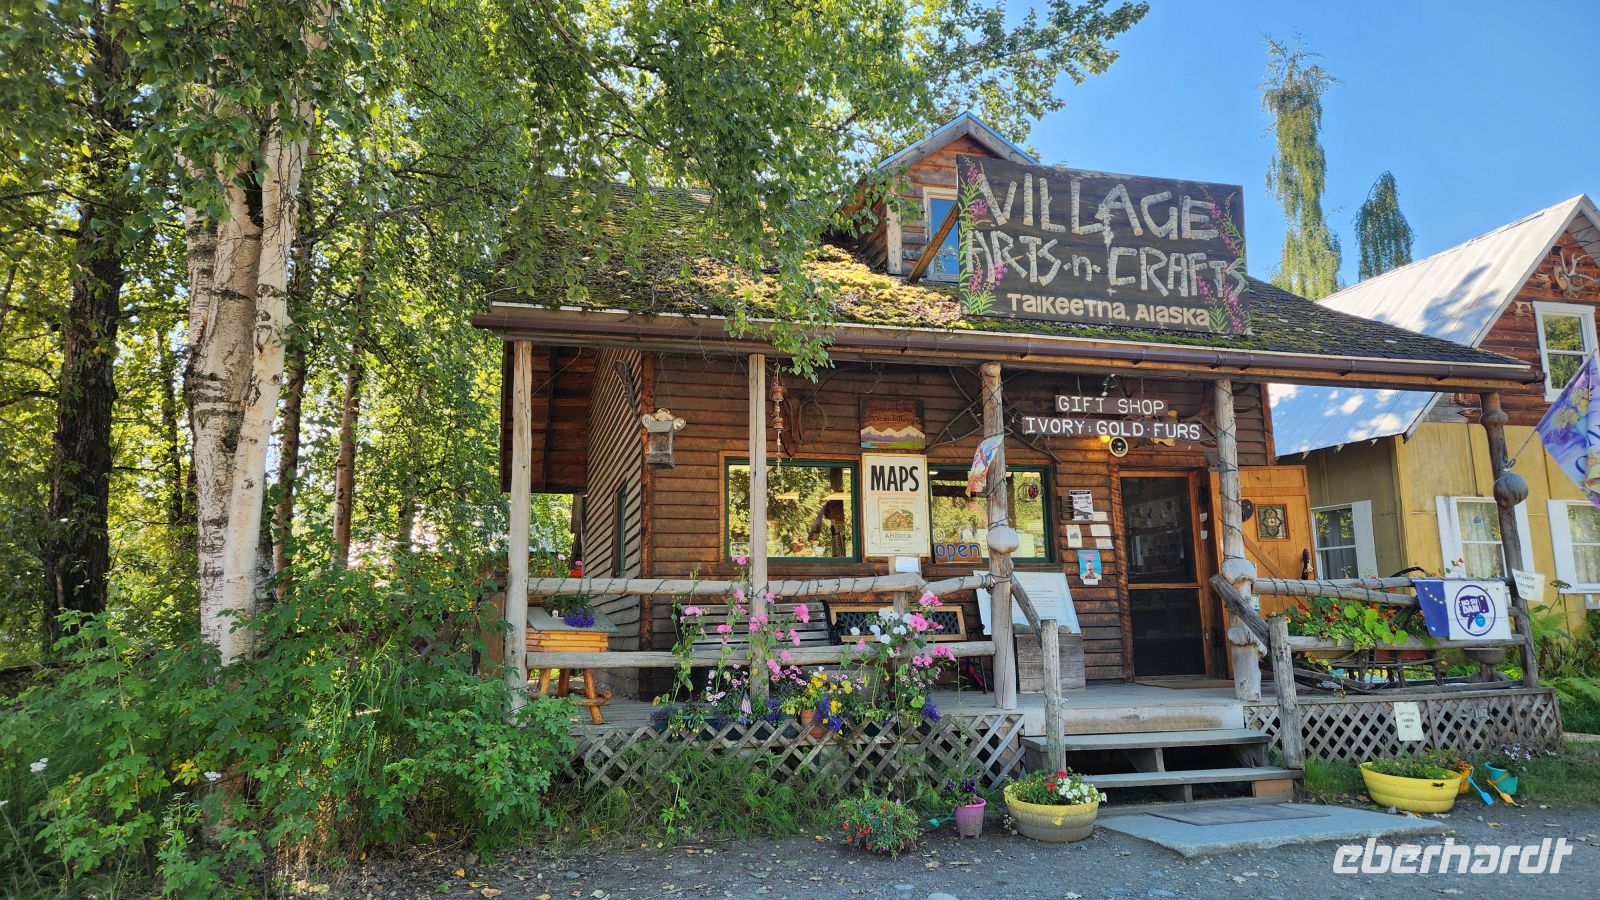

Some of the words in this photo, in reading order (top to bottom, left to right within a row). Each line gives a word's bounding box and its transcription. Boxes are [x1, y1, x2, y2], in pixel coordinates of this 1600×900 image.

[978, 159, 1219, 241] VILLAGE
[1058, 396, 1104, 413] GIFT
[1118, 398, 1164, 414] SHOP
[1025, 417, 1085, 434] IVORY
[1096, 420, 1144, 437] GOLD
[1153, 423, 1201, 440] FURS
[870, 465, 920, 492] MAPS
[935, 543, 981, 560] open
